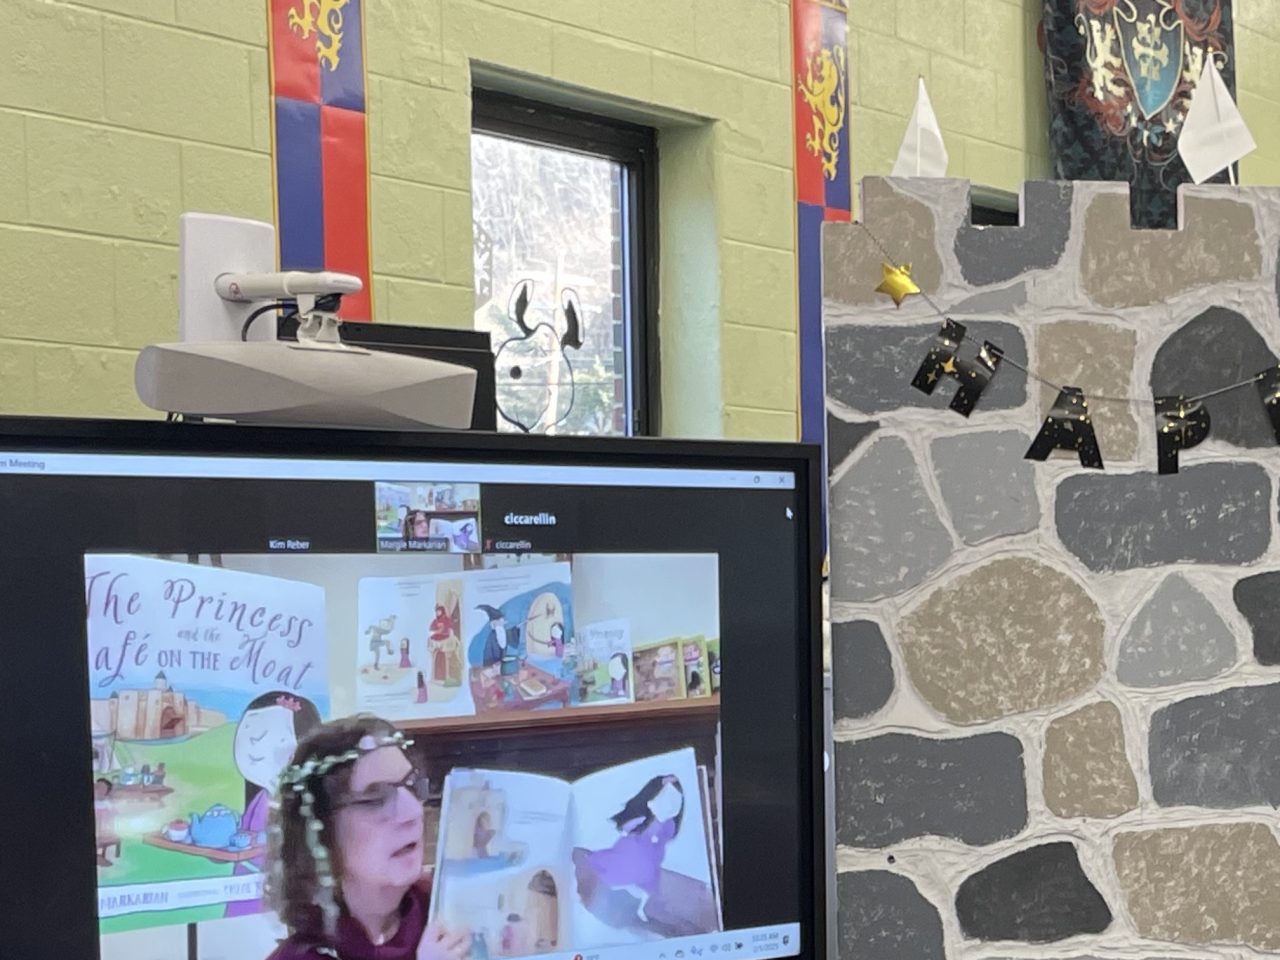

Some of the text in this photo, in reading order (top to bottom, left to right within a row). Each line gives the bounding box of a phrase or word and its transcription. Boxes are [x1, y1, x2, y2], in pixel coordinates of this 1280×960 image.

[268, 539, 310, 550] Kim Reber
[86, 571, 313, 649] The Princess
[177, 625, 221, 643] and the
[157, 649, 182, 668] ON
[189, 650, 221, 672] THE
[229, 630, 315, 690] Moat
